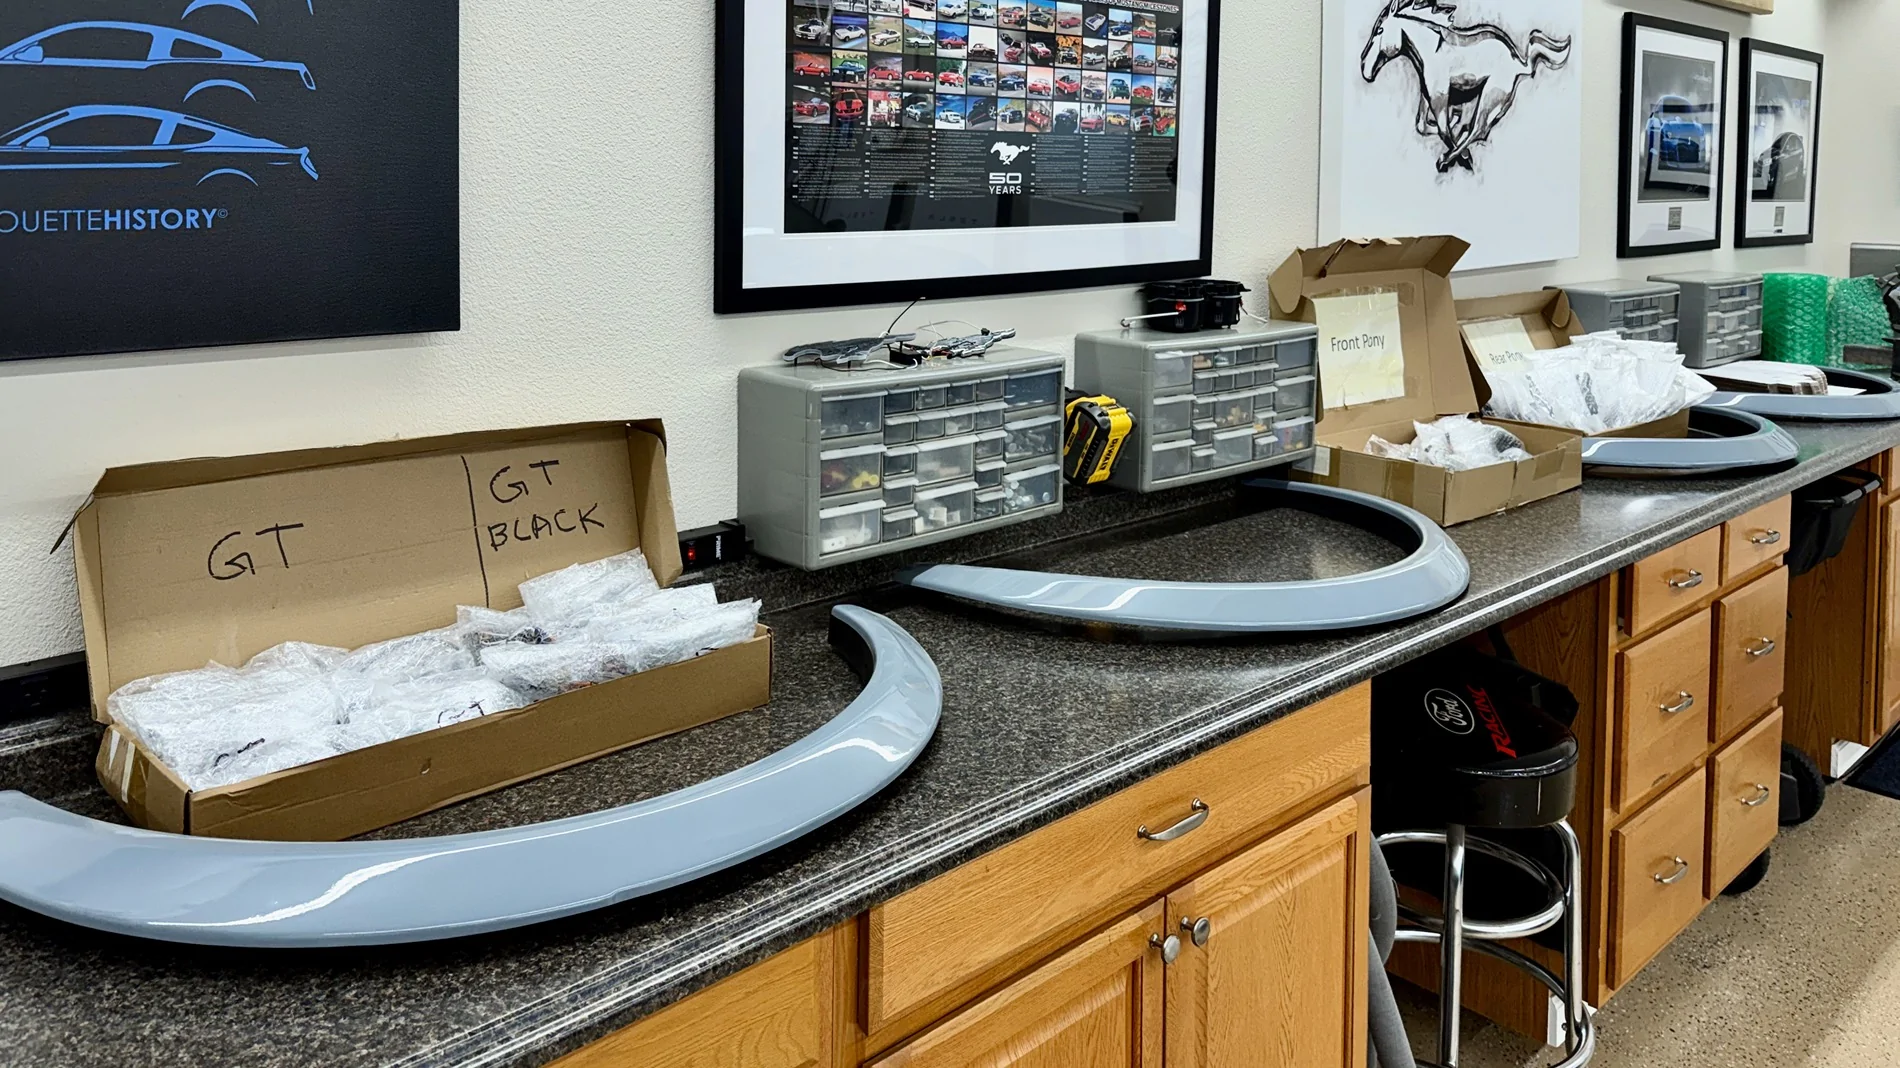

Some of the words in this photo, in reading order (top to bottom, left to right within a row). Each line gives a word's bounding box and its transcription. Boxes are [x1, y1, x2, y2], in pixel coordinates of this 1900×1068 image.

[988, 185, 1022, 195] YEARS
[989, 172, 1022, 184] 50
[1331, 336, 1360, 352] Front
[1362, 333, 1385, 350] Pony
[489, 460, 559, 503] GT
[487, 503, 605, 552] BLACK
[208, 523, 304, 581] GT
[1431, 696, 1468, 726] Ford
